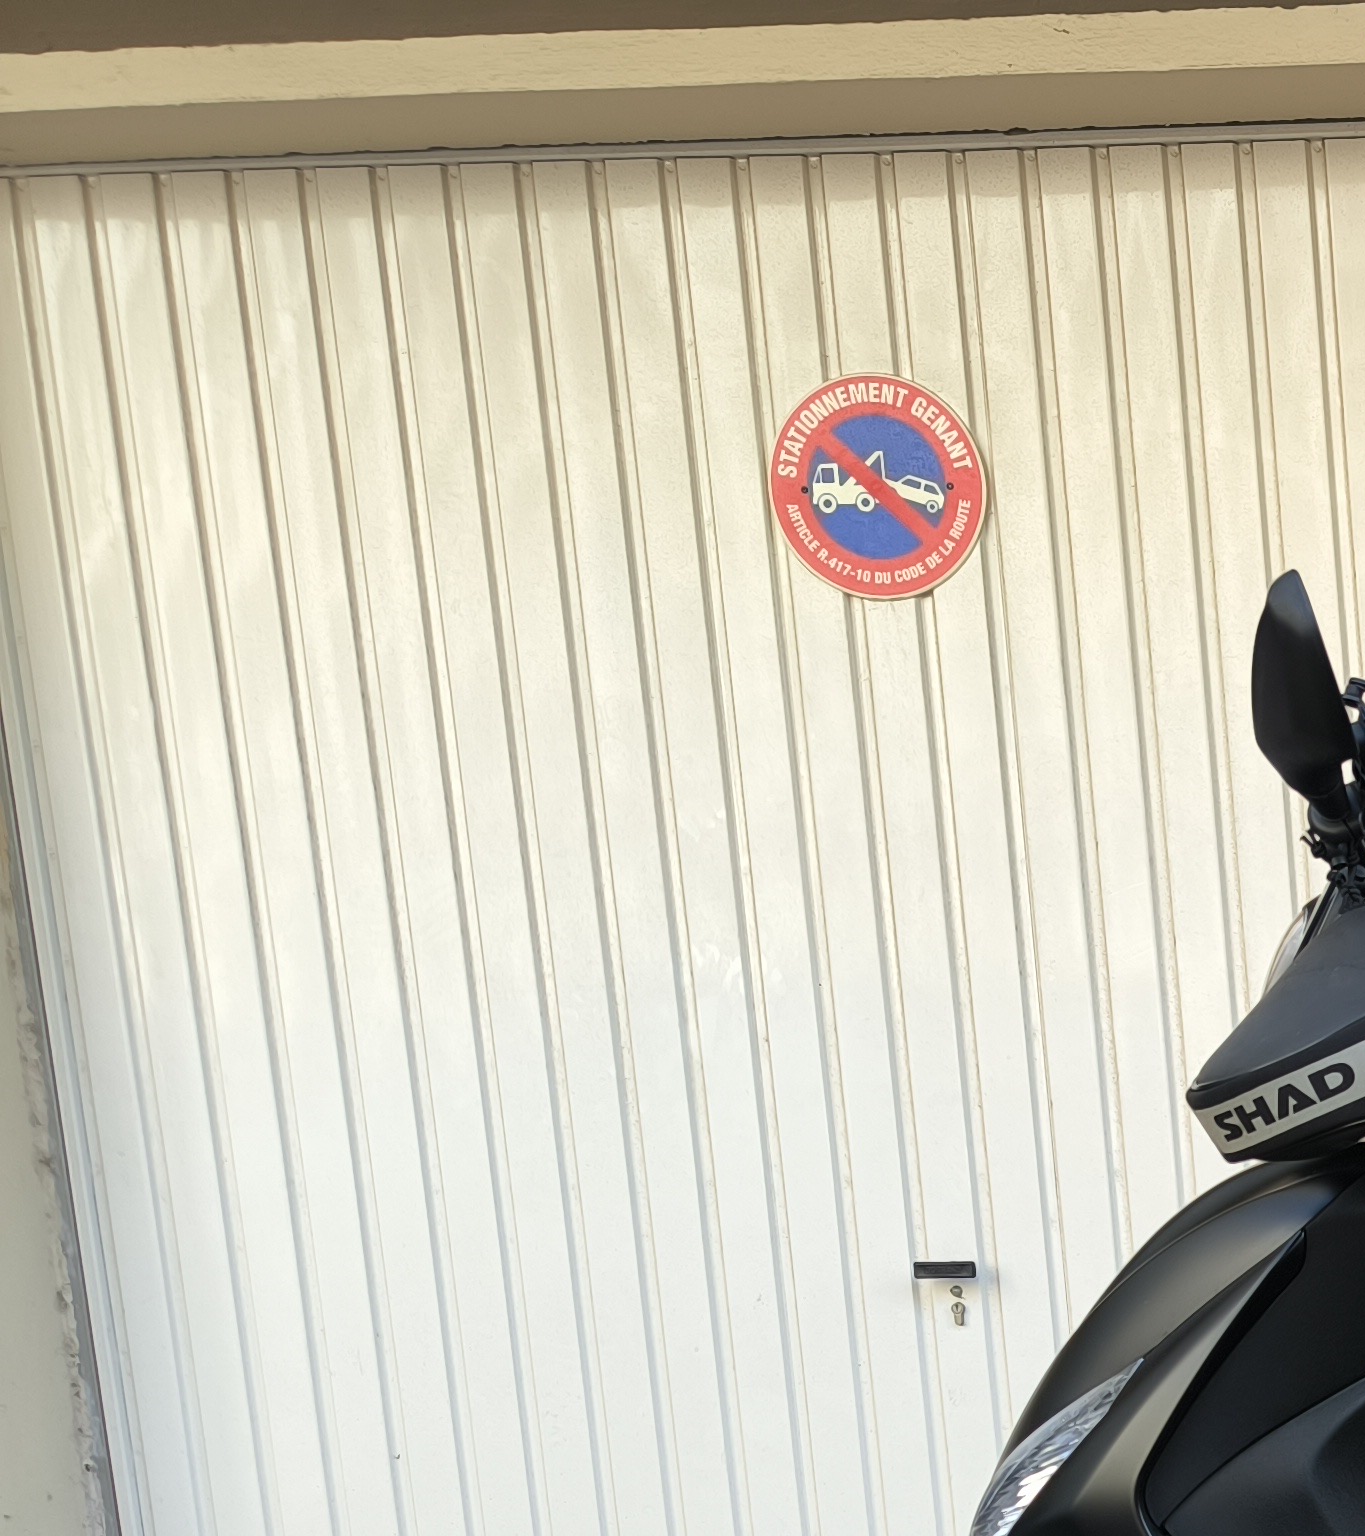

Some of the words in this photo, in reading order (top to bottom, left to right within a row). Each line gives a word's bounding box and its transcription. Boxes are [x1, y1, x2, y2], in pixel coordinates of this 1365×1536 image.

[778, 382, 908, 478] STATIONNEMENT
[910, 396, 973, 470] GENANT
[786, 503, 820, 552] ARTICLE
[816, 549, 870, 584] R.417-10
[874, 571, 892, 584] DU
[894, 562, 927, 583] CODE
[927, 551, 943, 569] DE
[939, 538, 956, 559] LA
[949, 499, 971, 540] ROUTE
[1212, 1062, 1356, 1143] SHAD
